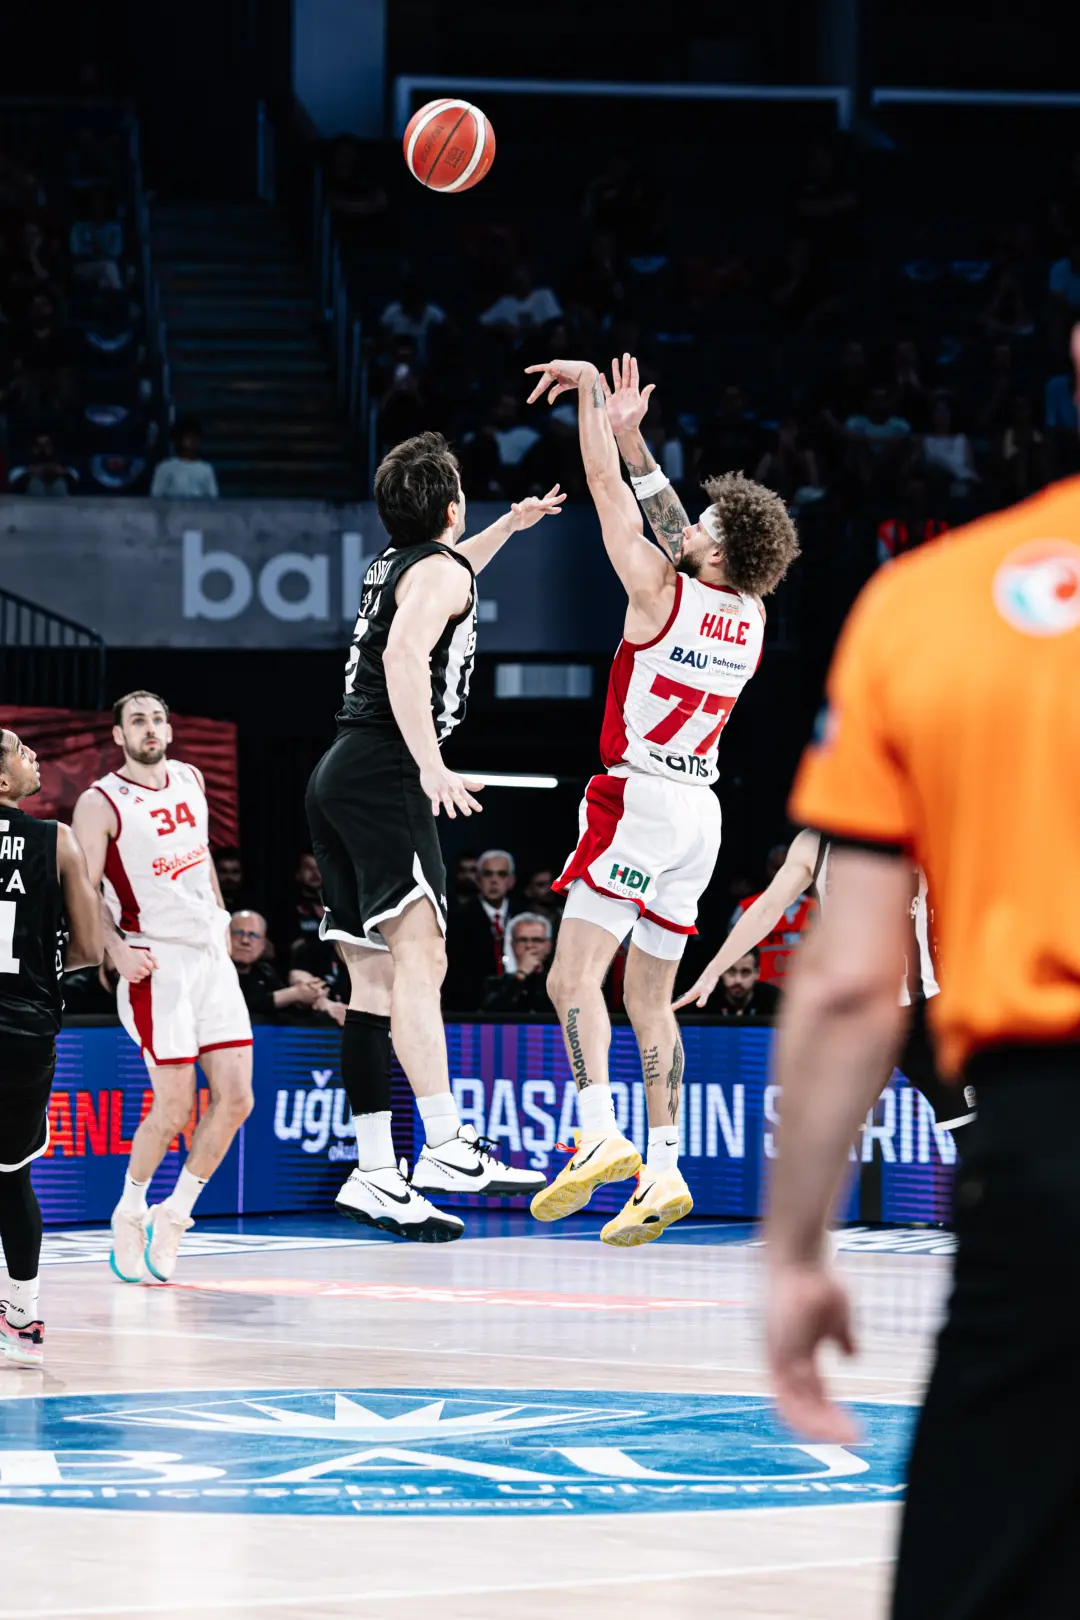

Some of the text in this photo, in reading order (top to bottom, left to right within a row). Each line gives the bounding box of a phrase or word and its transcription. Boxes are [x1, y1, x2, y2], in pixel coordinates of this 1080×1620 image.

[700, 613, 751, 646] HALE
[669, 646, 709, 669] BAU
[643, 674, 738, 756] 77
[150, 802, 196, 836] 34
[609, 863, 651, 895] HDI
[274, 1069, 358, 1154] uğu
[0, 1444, 873, 1484] BAU
